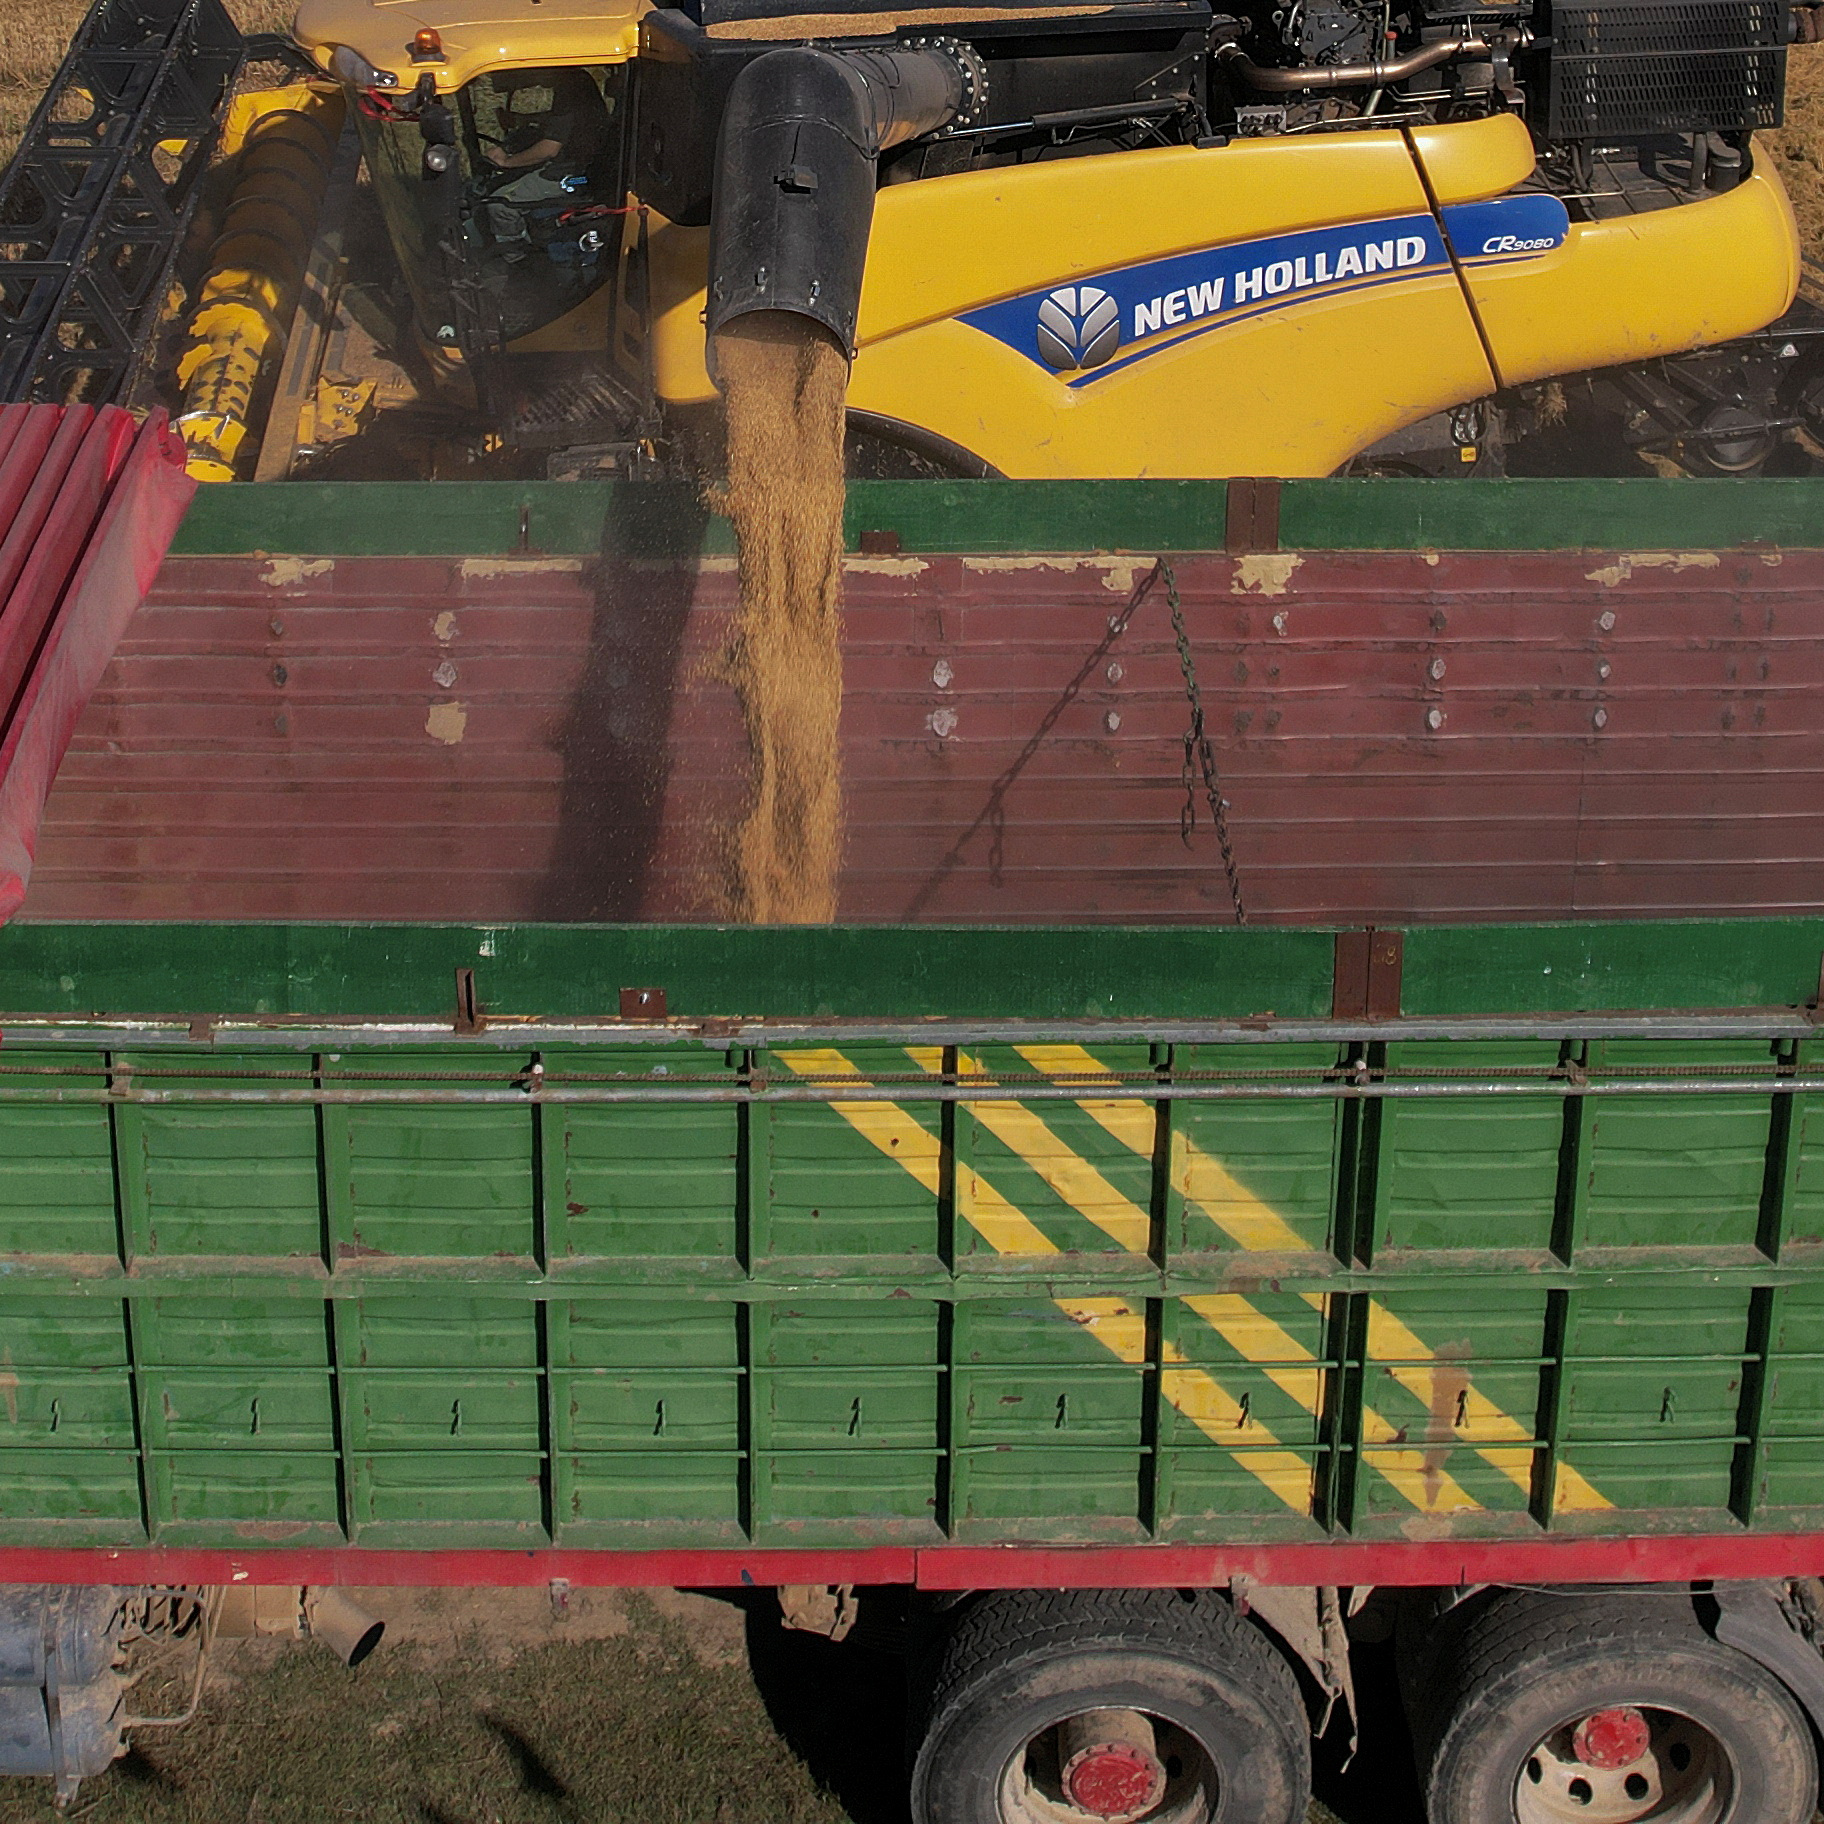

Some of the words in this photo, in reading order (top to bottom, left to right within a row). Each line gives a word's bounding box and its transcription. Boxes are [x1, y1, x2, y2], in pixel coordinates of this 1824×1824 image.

[1482, 235, 1554, 253] CR9080
[1135, 277, 1224, 336] NEW
[1235, 236, 1426, 303] HOLLAND
